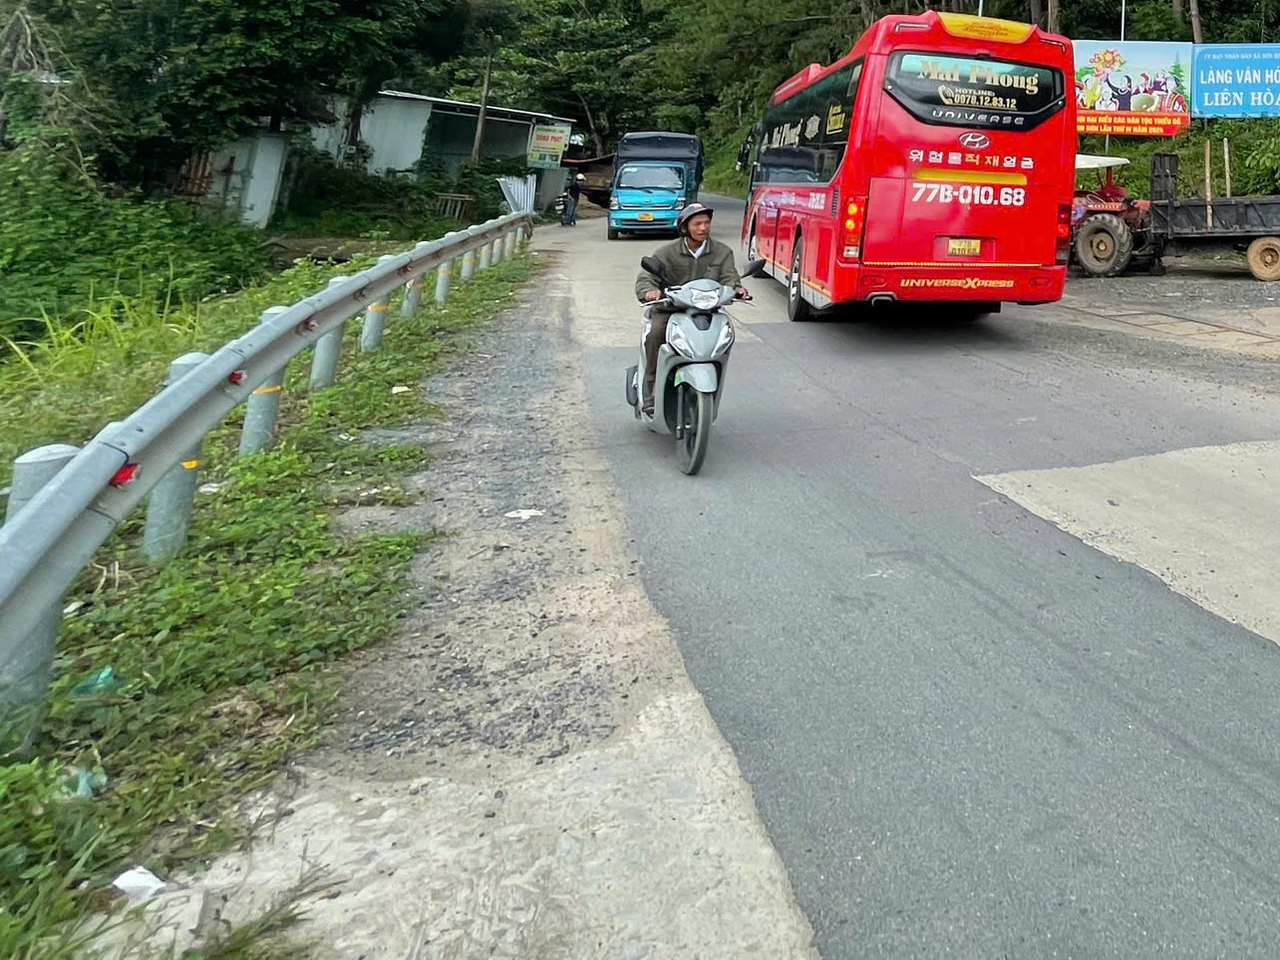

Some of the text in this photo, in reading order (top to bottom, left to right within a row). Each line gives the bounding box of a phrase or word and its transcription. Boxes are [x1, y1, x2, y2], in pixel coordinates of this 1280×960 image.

[917, 59, 1039, 95] Mai Phong
[1200, 66, 1233, 84] LÀNG
[1236, 67, 1261, 84] VĂN
[1203, 88, 1244, 106] LIÊN
[932, 109, 1025, 125] UNIVERSE
[911, 182, 1026, 207] 77B-010.68
